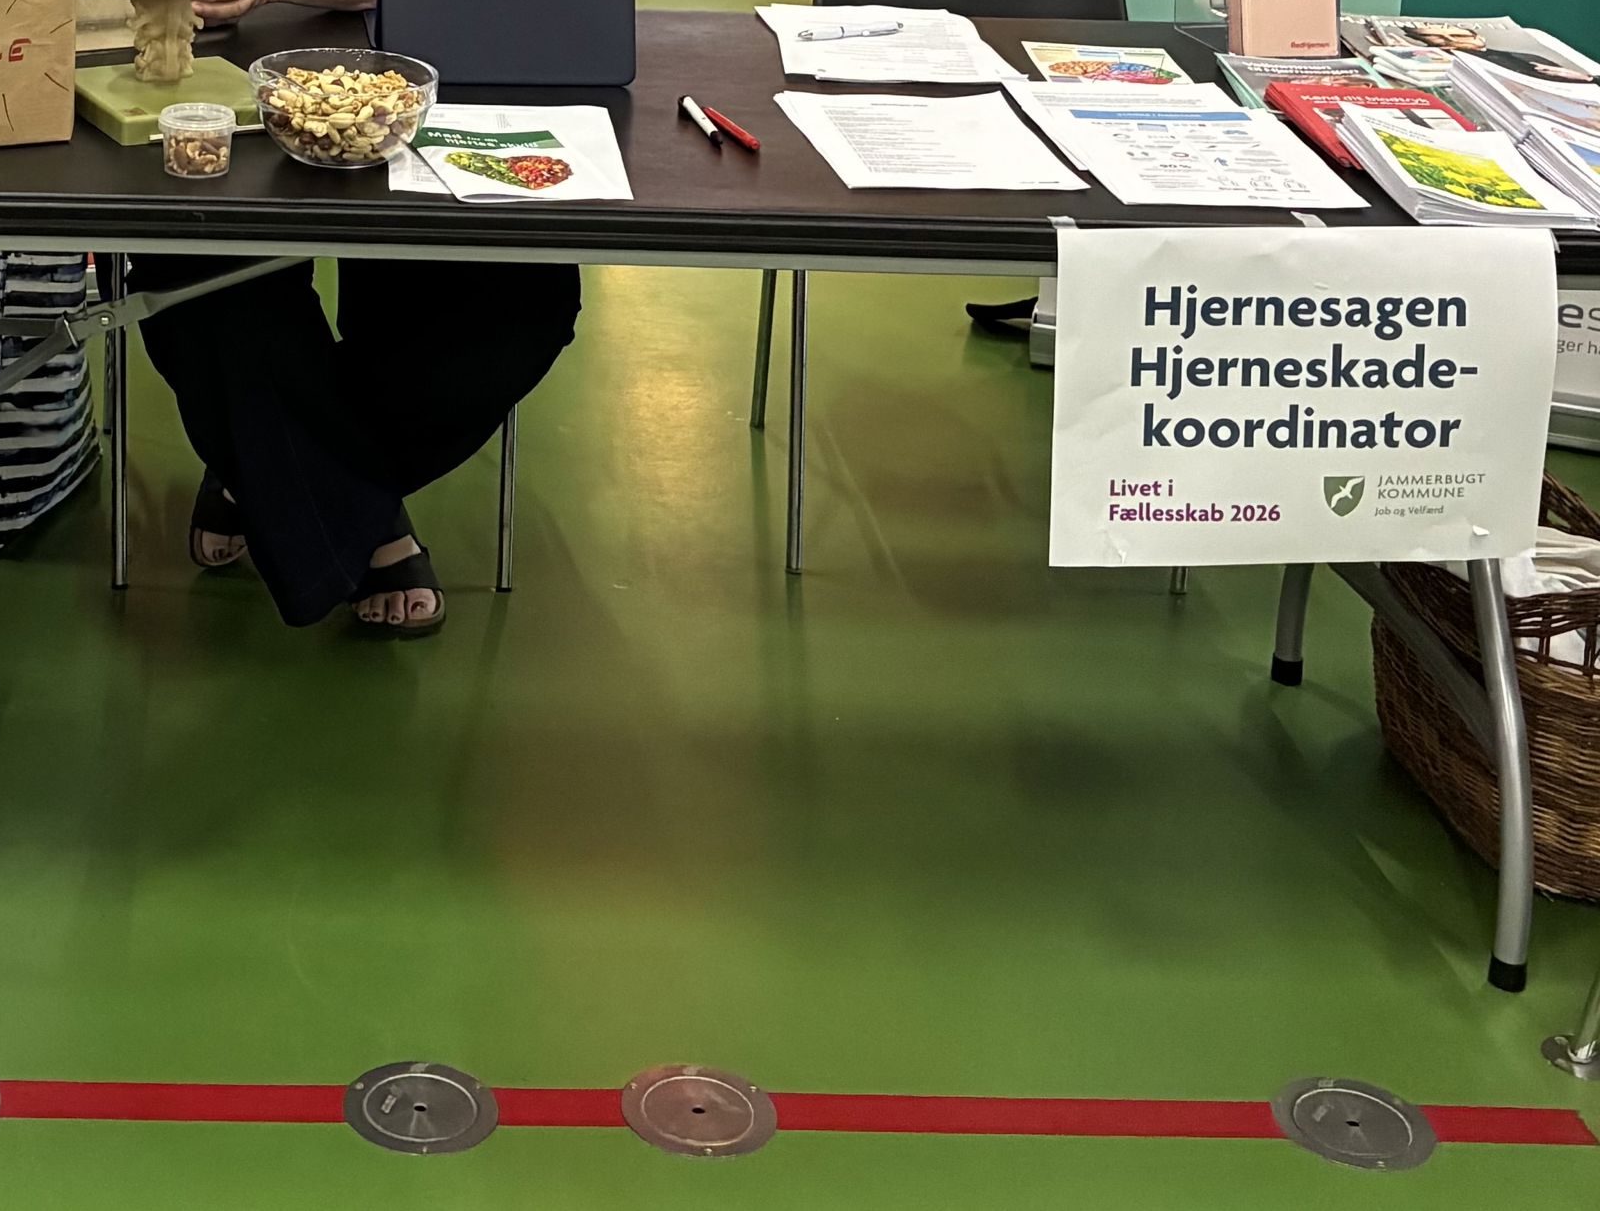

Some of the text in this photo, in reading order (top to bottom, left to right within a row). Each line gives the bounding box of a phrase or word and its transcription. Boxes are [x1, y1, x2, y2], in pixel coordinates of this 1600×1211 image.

[1144, 284, 1467, 341] Hjernesagen
[1130, 343, 1479, 400] Hjerneskade-
[1142, 403, 1462, 449] koordinator
[1109, 479, 1175, 497] Livet i
[1377, 473, 1486, 487] JAMMERBUGT
[1378, 487, 1465, 499] KOMMUNE
[1108, 502, 1281, 523] Fællesskab 2026
[1374, 504, 1444, 517] Job og Velfærd
